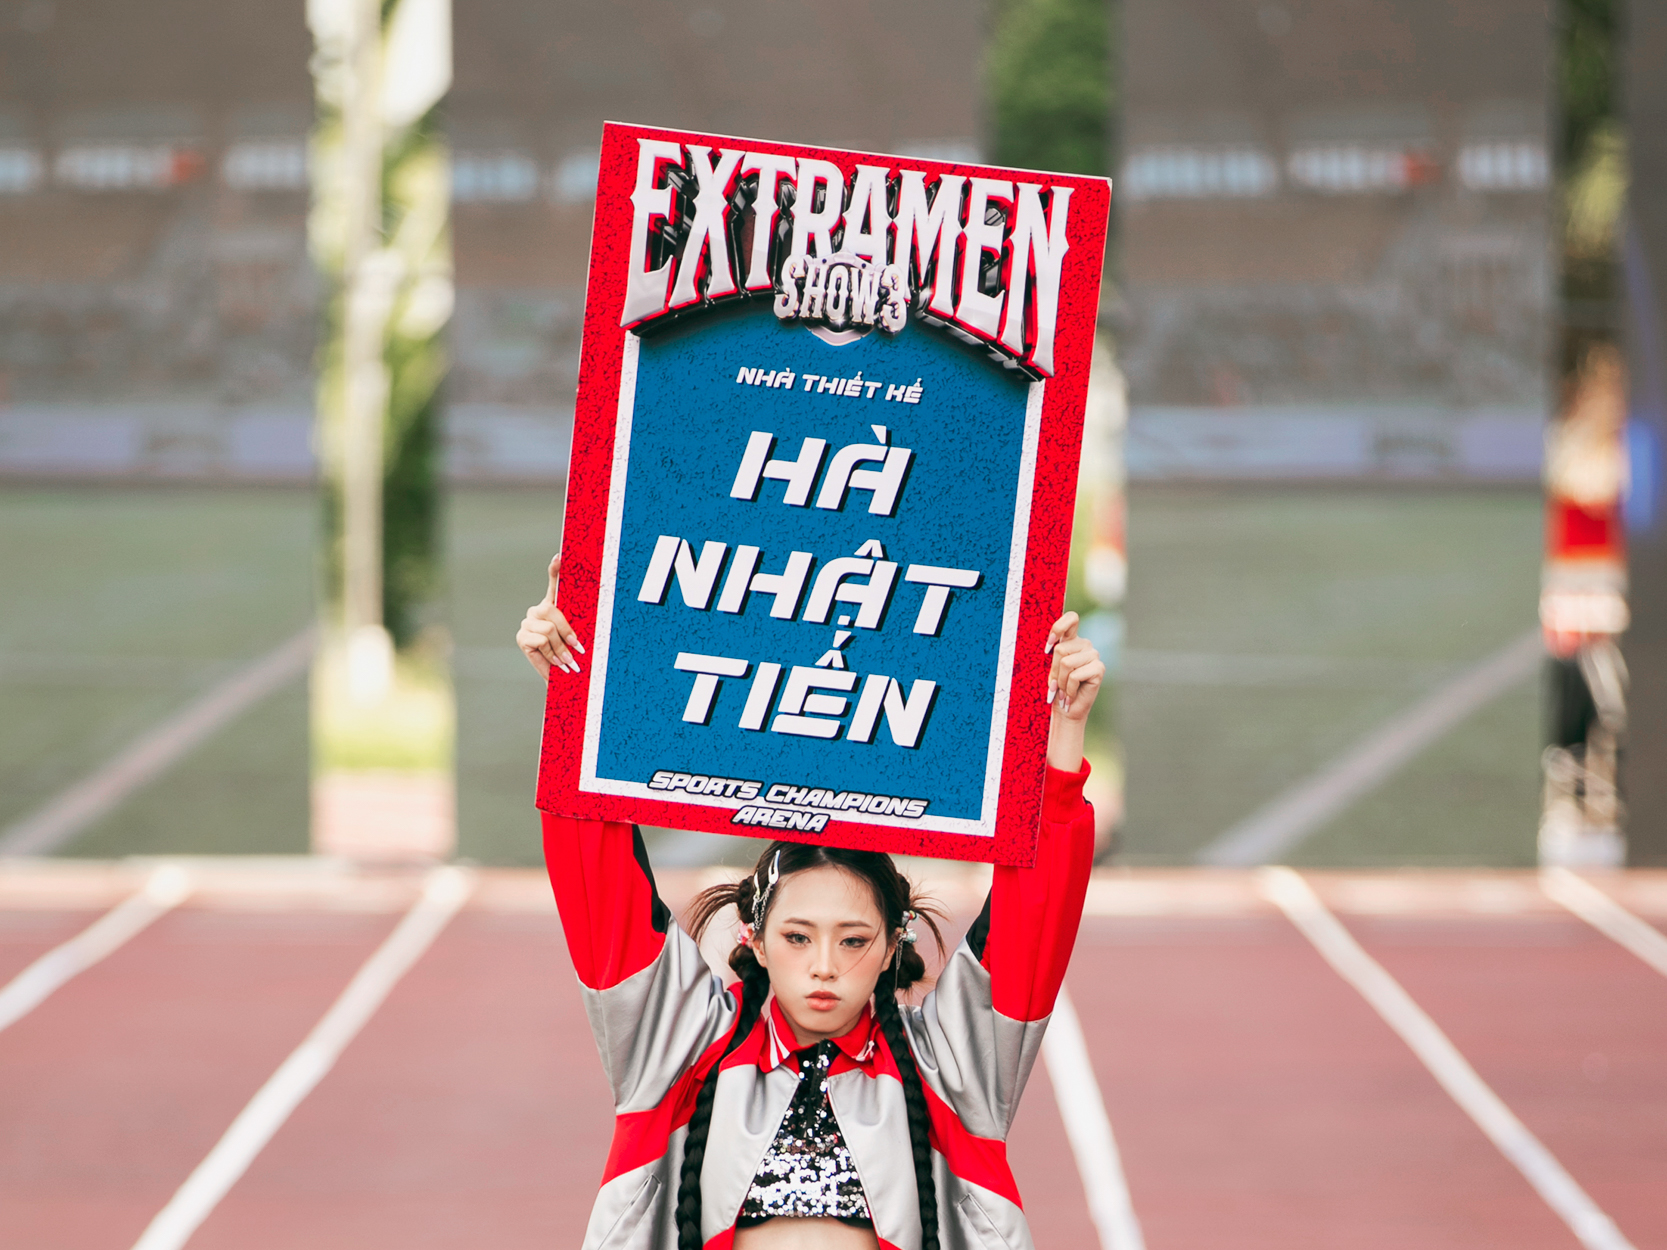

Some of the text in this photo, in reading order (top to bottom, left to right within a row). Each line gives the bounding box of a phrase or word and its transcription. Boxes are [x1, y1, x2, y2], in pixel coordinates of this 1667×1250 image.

[620, 138, 1075, 378] EXTRAMEN
[735, 366, 924, 404] NHÀ THIẾT KẾ
[730, 424, 912, 515] HÀ
[637, 534, 980, 635] NHẬT
[673, 630, 936, 747] TIẾN
[649, 770, 928, 818] SPORTS CHAMPIONS
[731, 806, 830, 832] ARENA
